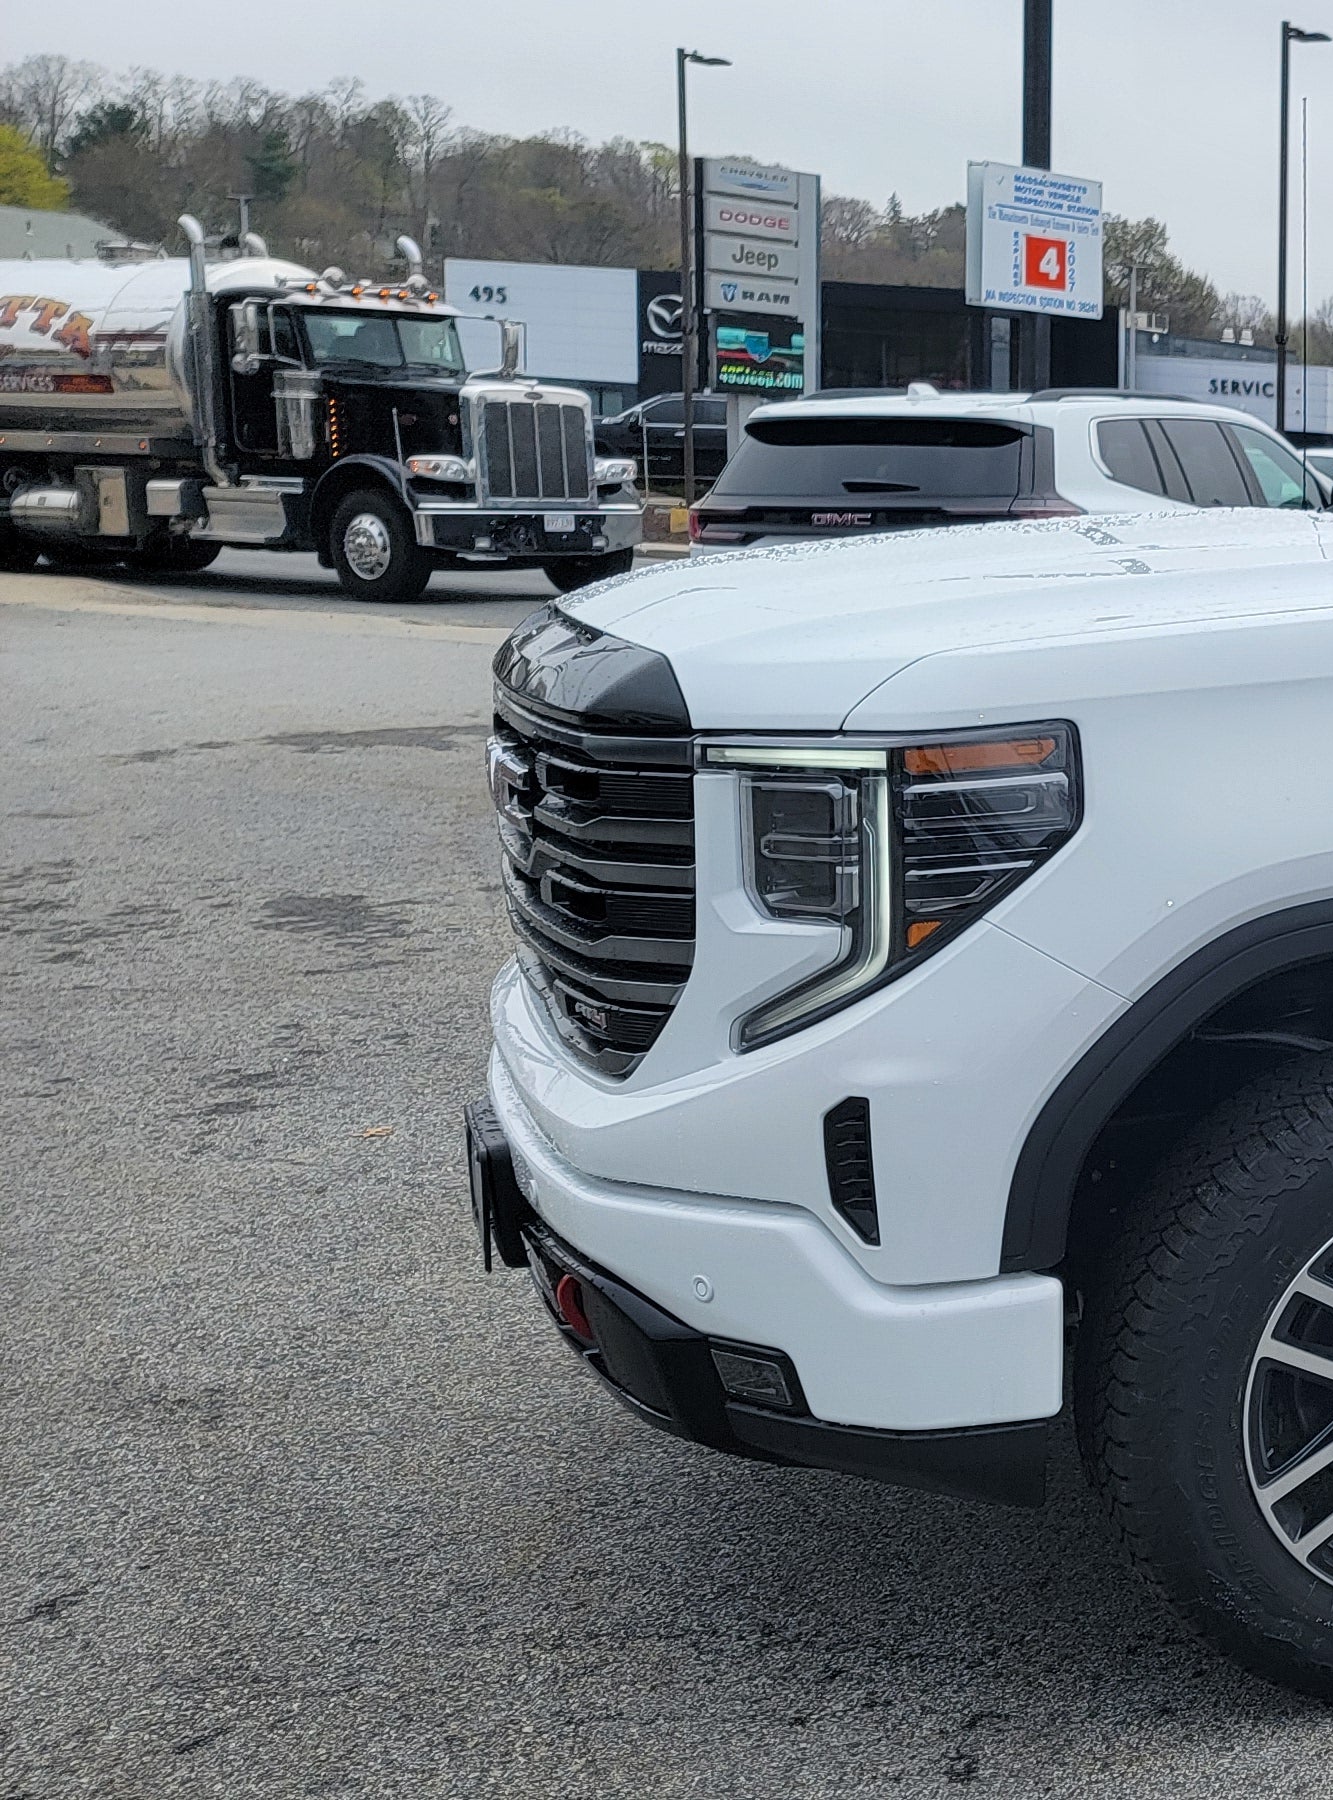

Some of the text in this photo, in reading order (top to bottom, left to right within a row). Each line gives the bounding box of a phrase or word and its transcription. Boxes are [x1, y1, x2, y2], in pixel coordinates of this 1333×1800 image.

[720, 209, 790, 231] DODGE
[731, 244, 779, 271] Jeep
[1038, 247, 1060, 281] 4
[1067, 241, 1076, 293] 2027
[469, 285, 507, 304] 495
[741, 290, 791, 305] RAM
[1207, 378, 1275, 399] SERVIC
[811, 512, 872, 526] GMC
